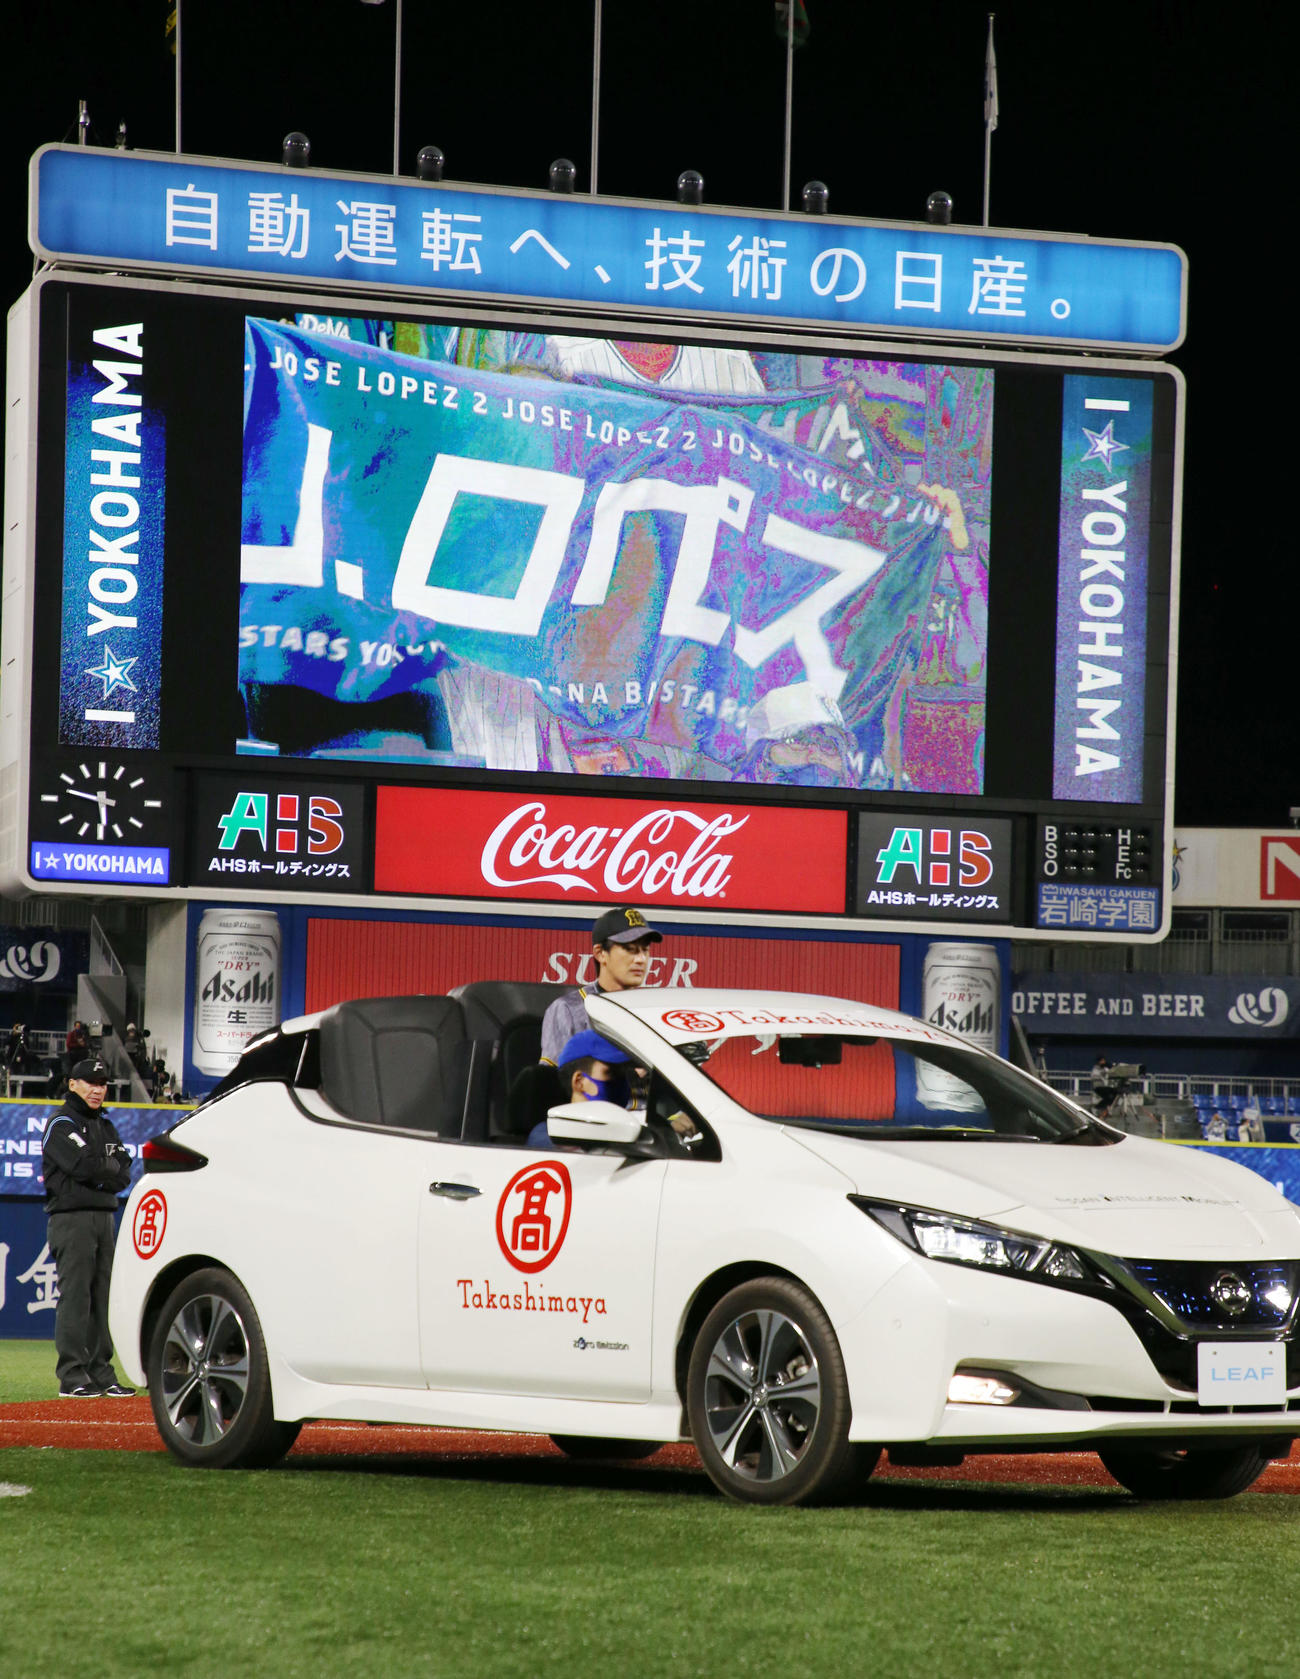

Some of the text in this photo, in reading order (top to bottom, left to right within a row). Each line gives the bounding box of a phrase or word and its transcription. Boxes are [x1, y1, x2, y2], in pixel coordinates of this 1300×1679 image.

[164, 183, 1072, 321] 自動運転へ、技術の日産。
[270, 346, 342, 386] JOSE
[357, 366, 459, 410] LOPEZ
[473, 391, 489, 414] 2
[502, 397, 573, 431] JOSE
[87, 322, 144, 637] YOKOHAMA
[1074, 480, 1128, 777] YOKOHAMA
[218, 792, 345, 856] AHS
[1045, 825, 1058, 842] B
[1118, 829, 1131, 845] H
[62, 852, 165, 876] YOKOHAMA
[481, 802, 750, 897] Coca-Cola
[875, 826, 994, 888] AHS
[1045, 843, 1058, 859] S
[1118, 846, 1130, 862] E
[208, 857, 350, 878] AHSホールディングス
[1044, 860, 1058, 876] O
[867, 890, 999, 909] AHSホールディングス
[1059, 886, 1156, 899] IWASAKI GAKUEN
[1039, 895, 1155, 929] 岩崎学園
[541, 952, 698, 988] SUER
[202, 970, 274, 1004] Asahi
[227, 1010, 248, 1024] 生
[928, 1001, 993, 1034] Asahi
[1142, 993, 1205, 1018] BEER
[457, 1279, 607, 1324] Takashimaya
[1210, 1366, 1275, 1382] LEAF
